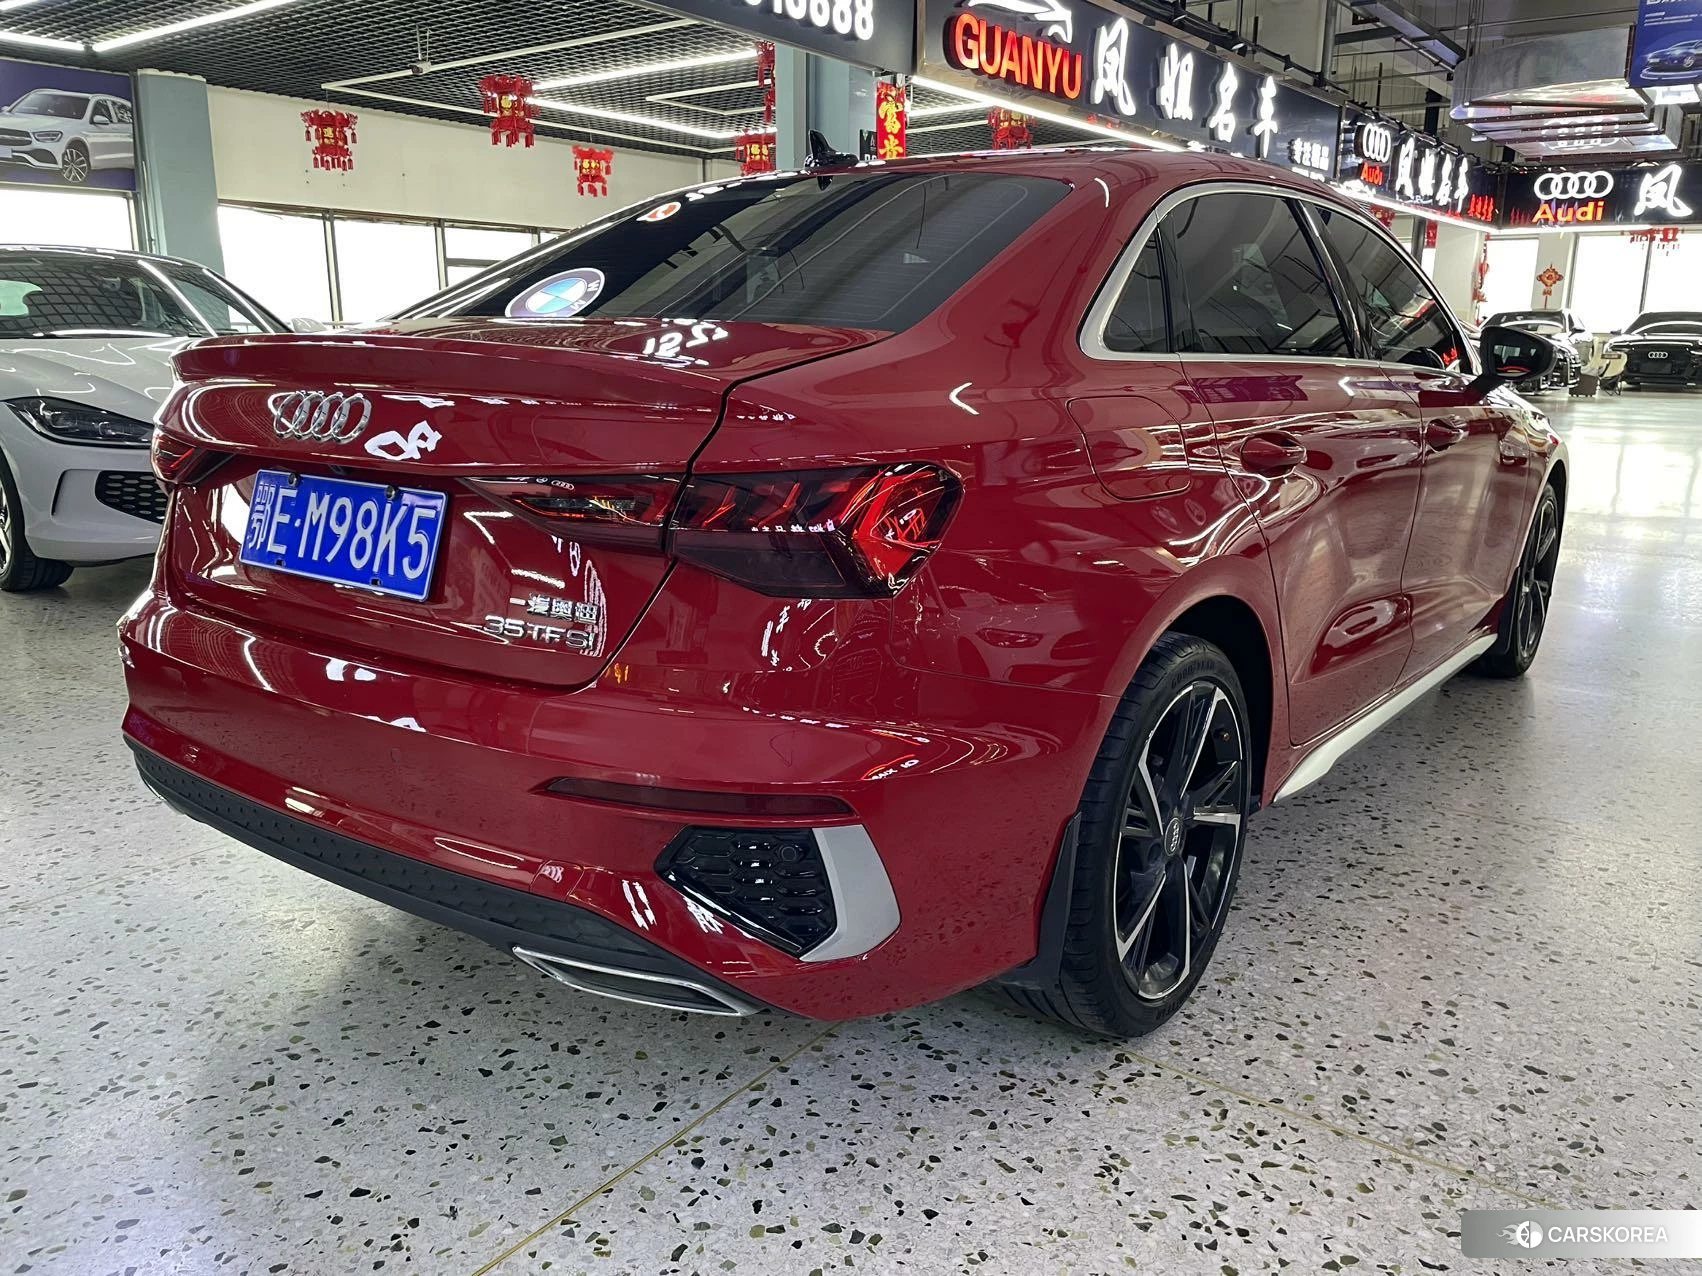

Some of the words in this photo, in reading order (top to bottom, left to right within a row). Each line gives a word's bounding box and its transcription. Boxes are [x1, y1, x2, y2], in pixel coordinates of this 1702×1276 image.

[955, 12, 1082, 100] GUANYU
[1360, 161, 1384, 187] Audi
[1531, 201, 1605, 224] Audi
